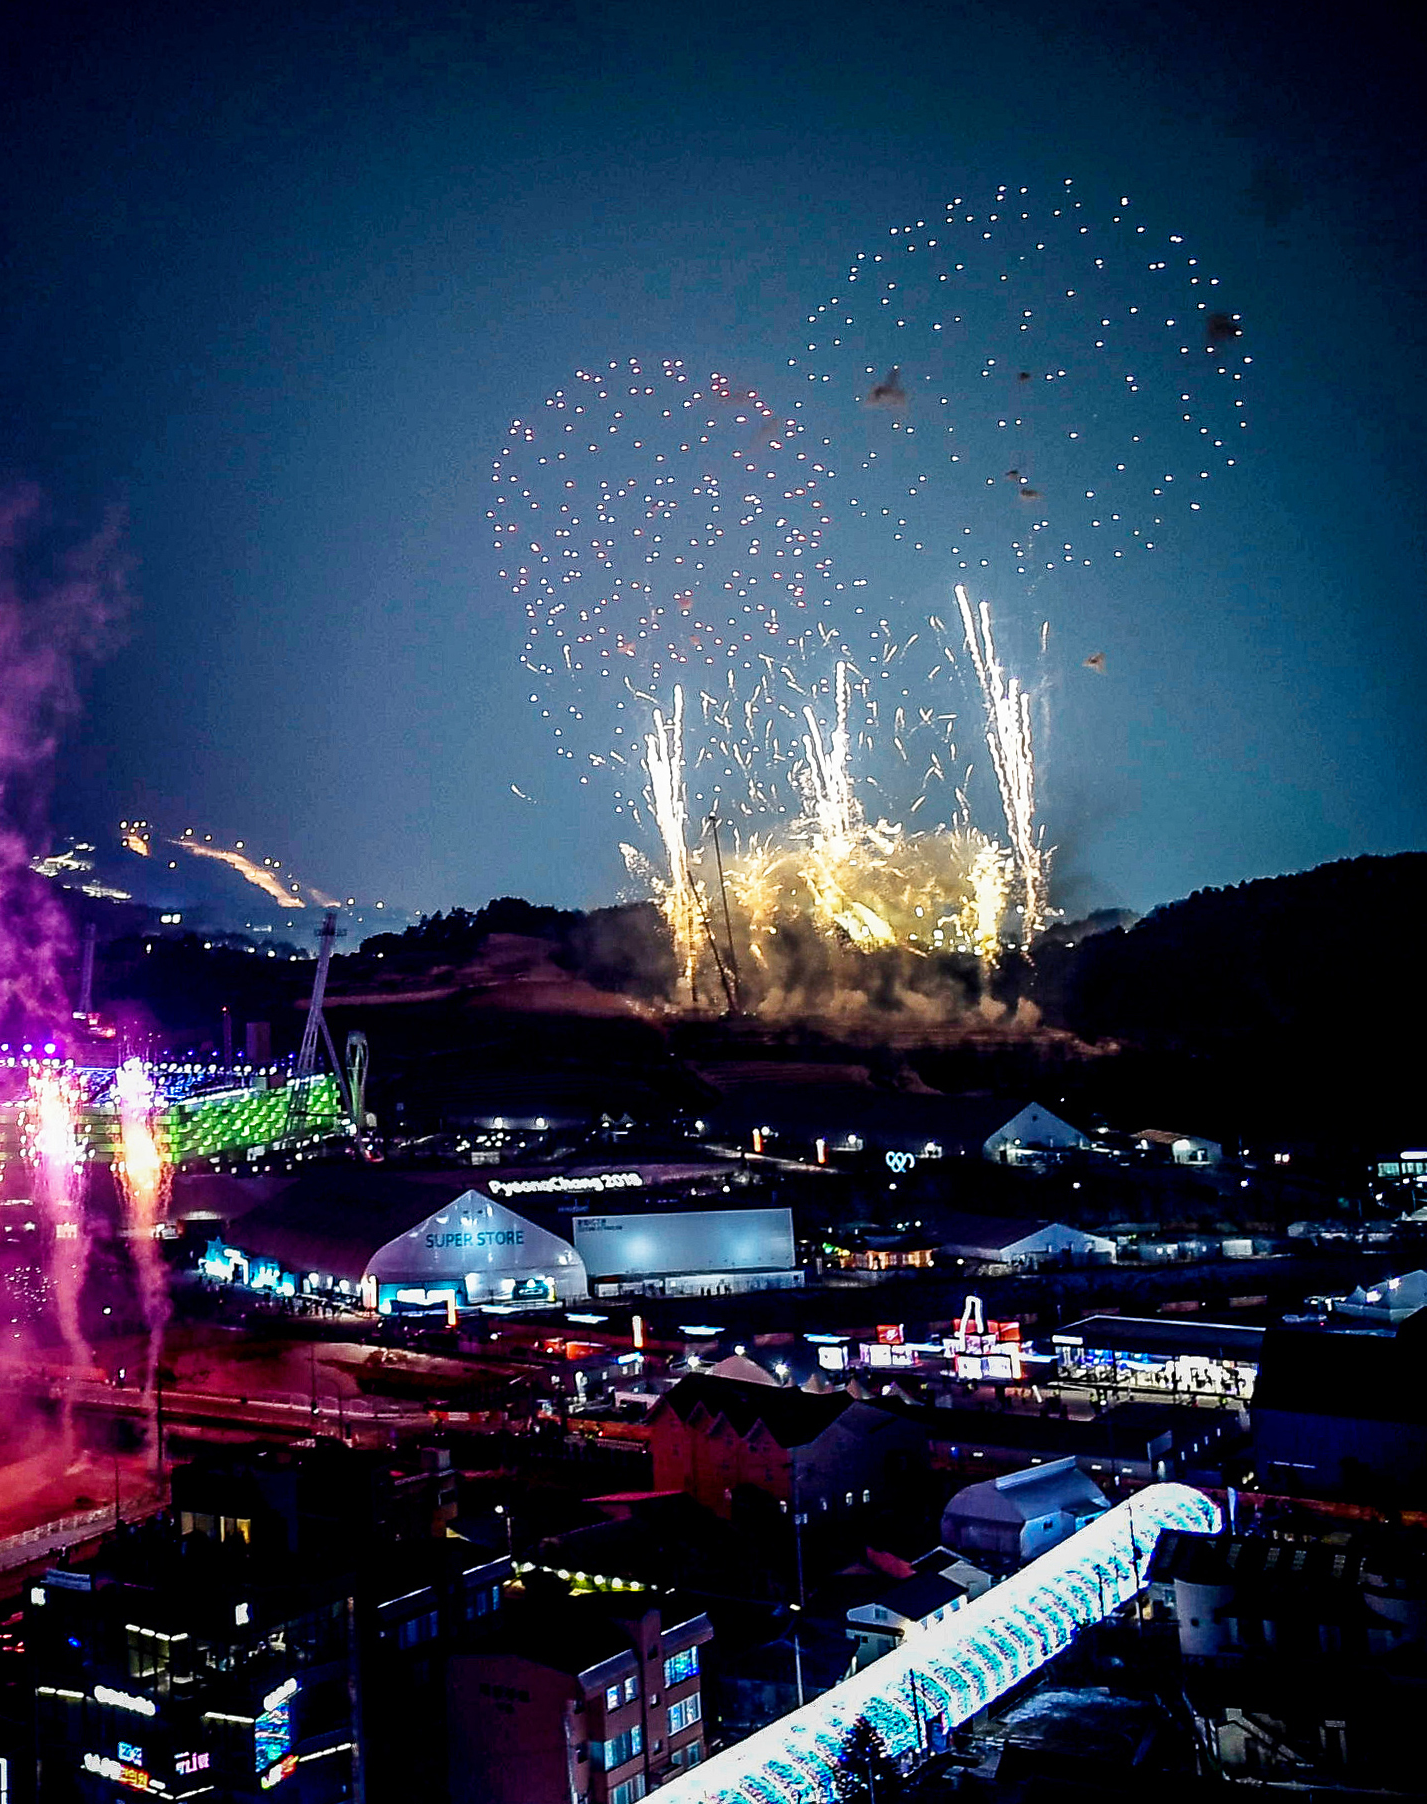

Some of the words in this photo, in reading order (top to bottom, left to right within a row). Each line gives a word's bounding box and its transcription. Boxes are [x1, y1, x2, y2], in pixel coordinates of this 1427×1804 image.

[488, 1176, 604, 1197] PyeongChang
[601, 1173, 643, 1188] 2018
[426, 1232, 473, 1248] SUPER
[477, 1230, 524, 1246] STORE
